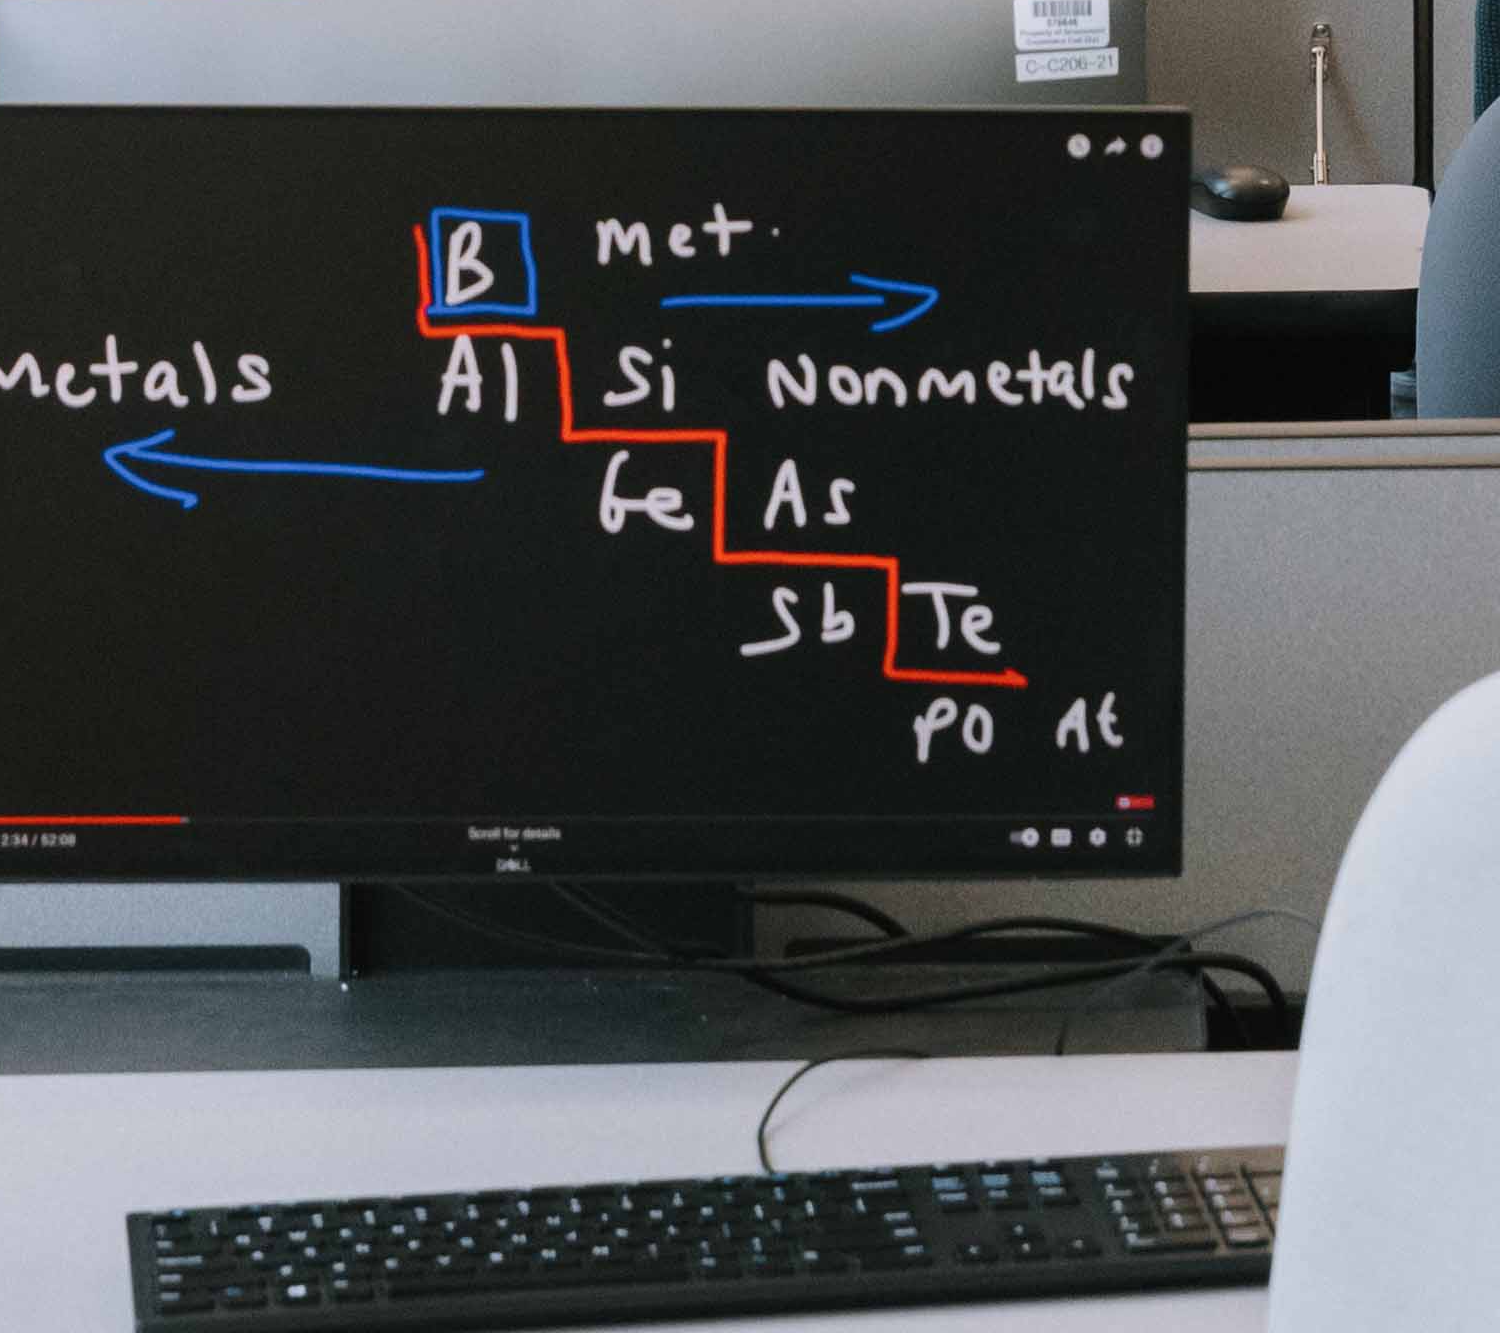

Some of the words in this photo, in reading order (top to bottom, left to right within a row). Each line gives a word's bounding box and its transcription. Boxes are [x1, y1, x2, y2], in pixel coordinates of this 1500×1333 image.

[1025, 53, 1114, 74] C-C206-21
[445, 220, 495, 307] B
[603, 338, 676, 413] Si
[766, 347, 1136, 411] Nonmetals
[763, 458, 856, 531] As
[740, 581, 856, 657] Sb
[900, 581, 1002, 655] Te
[1055, 691, 1125, 754] At
